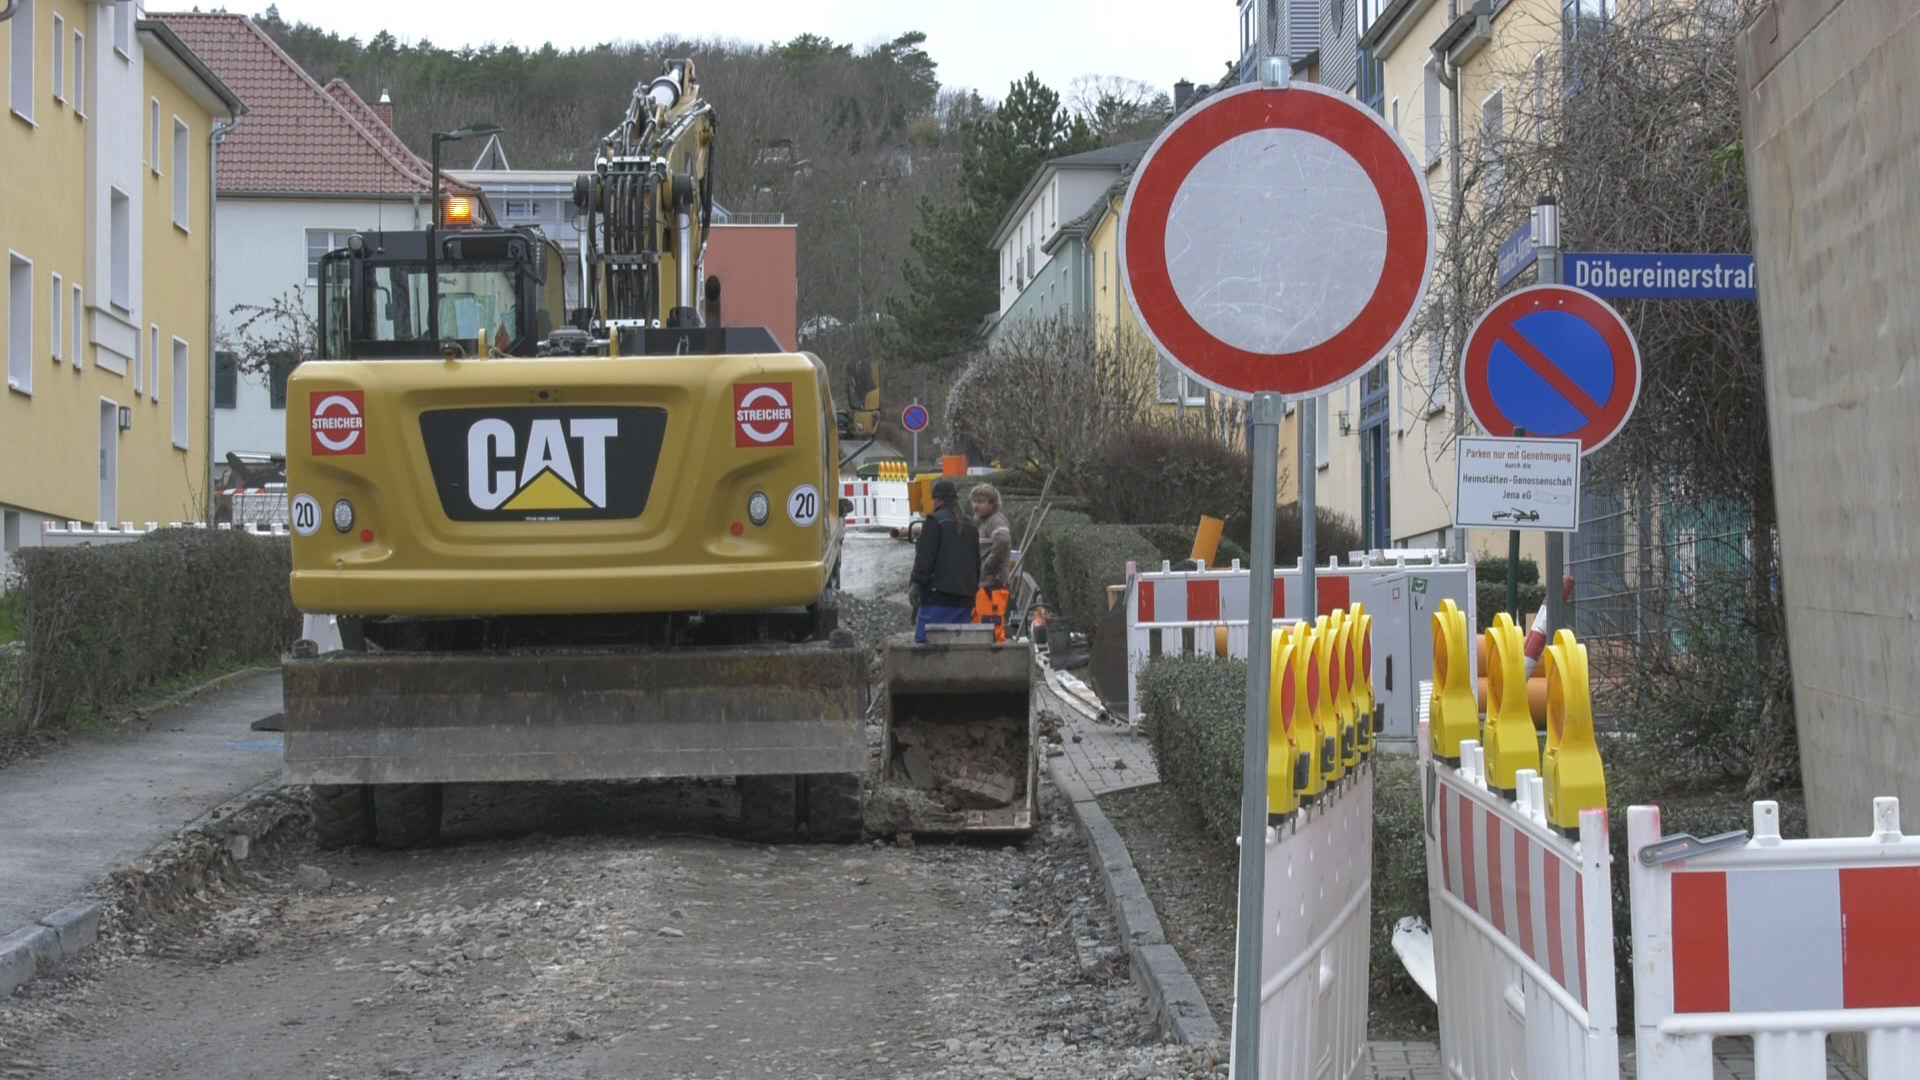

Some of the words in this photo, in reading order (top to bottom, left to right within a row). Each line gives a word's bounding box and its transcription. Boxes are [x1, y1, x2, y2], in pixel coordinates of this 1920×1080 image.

[737, 408, 792, 421] STREICHER
[311, 417, 363, 430] STREICHER
[1466, 448, 1491, 458] Parken
[1493, 451, 1505, 459] nur
[1507, 451, 1519, 460] mit
[1521, 450, 1571, 463] Genehmigung
[468, 417, 619, 511] CAT
[1462, 473, 1573, 486] Heimstätten-Genossenschaft
[1502, 490, 1520, 499] Jena
[1521, 491, 1532, 499] eG
[795, 492, 815, 519] 20
[295, 502, 315, 528] 20
